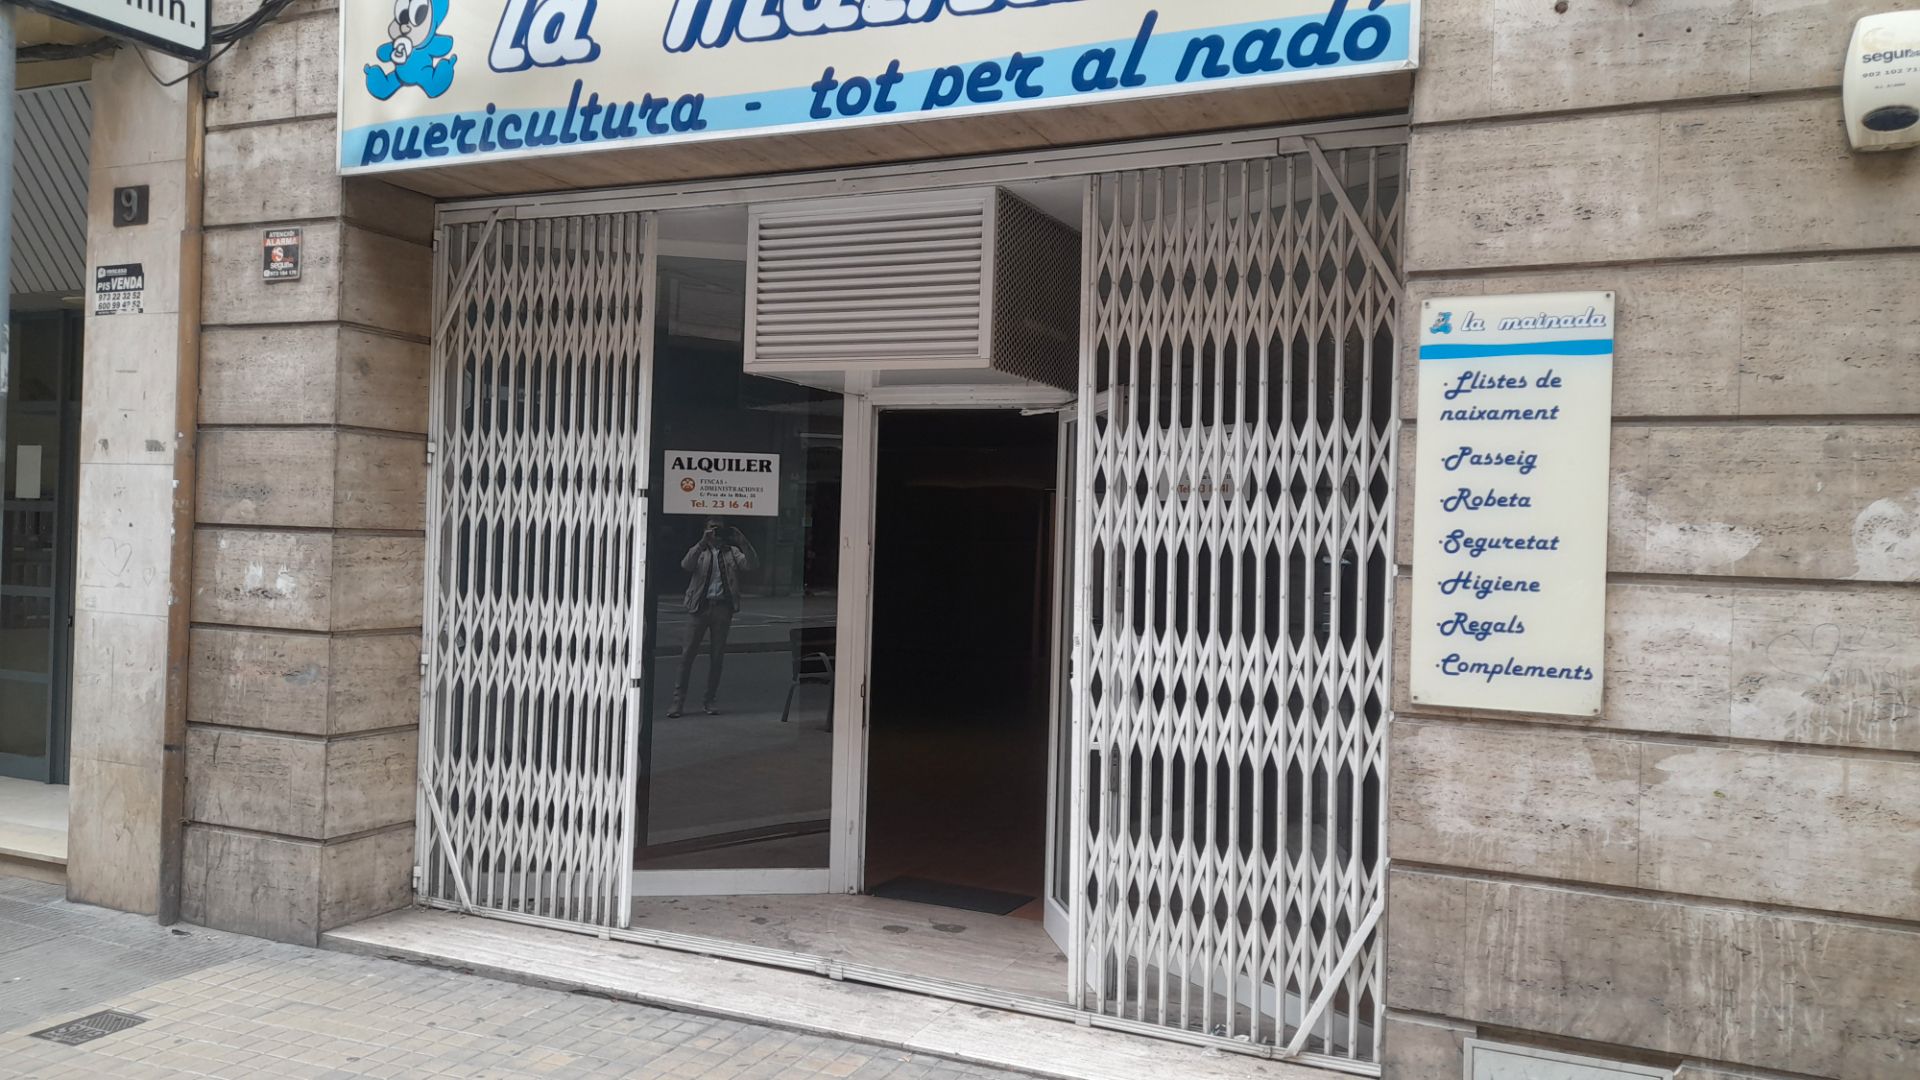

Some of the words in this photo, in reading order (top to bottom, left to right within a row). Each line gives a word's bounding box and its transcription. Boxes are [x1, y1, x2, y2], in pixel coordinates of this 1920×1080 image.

[488, 0, 601, 73] la
[361, 80, 708, 166] puericultura
[810, 60, 905, 119] tot
[920, 53, 1045, 111] per
[1071, 10, 1160, 93] al
[1175, 0, 1392, 82] nadó
[121, 189, 138, 221] 9
[266, 237, 298, 246] ALARMA
[97, 282, 111, 291] PIS
[111, 276, 143, 290] VENDA
[1461, 311, 1485, 331] la
[1498, 307, 1606, 330] mainada
[1444, 370, 1527, 400] Llistes
[1535, 369, 1562, 389] de
[1440, 405, 1560, 421] naixament
[671, 456, 773, 473] ALQUILER
[1444, 446, 1537, 475] Passeig
[691, 500, 708, 508] Tel.
[712, 500, 725, 508] 23
[729, 501, 740, 509] 16
[743, 501, 753, 509] 41
[1442, 488, 1532, 512] Robeta
[1443, 529, 1560, 558] Seguretat
[1440, 571, 1541, 600] Higiene
[1439, 612, 1525, 641] Regals
[1441, 653, 1593, 683] Complements
